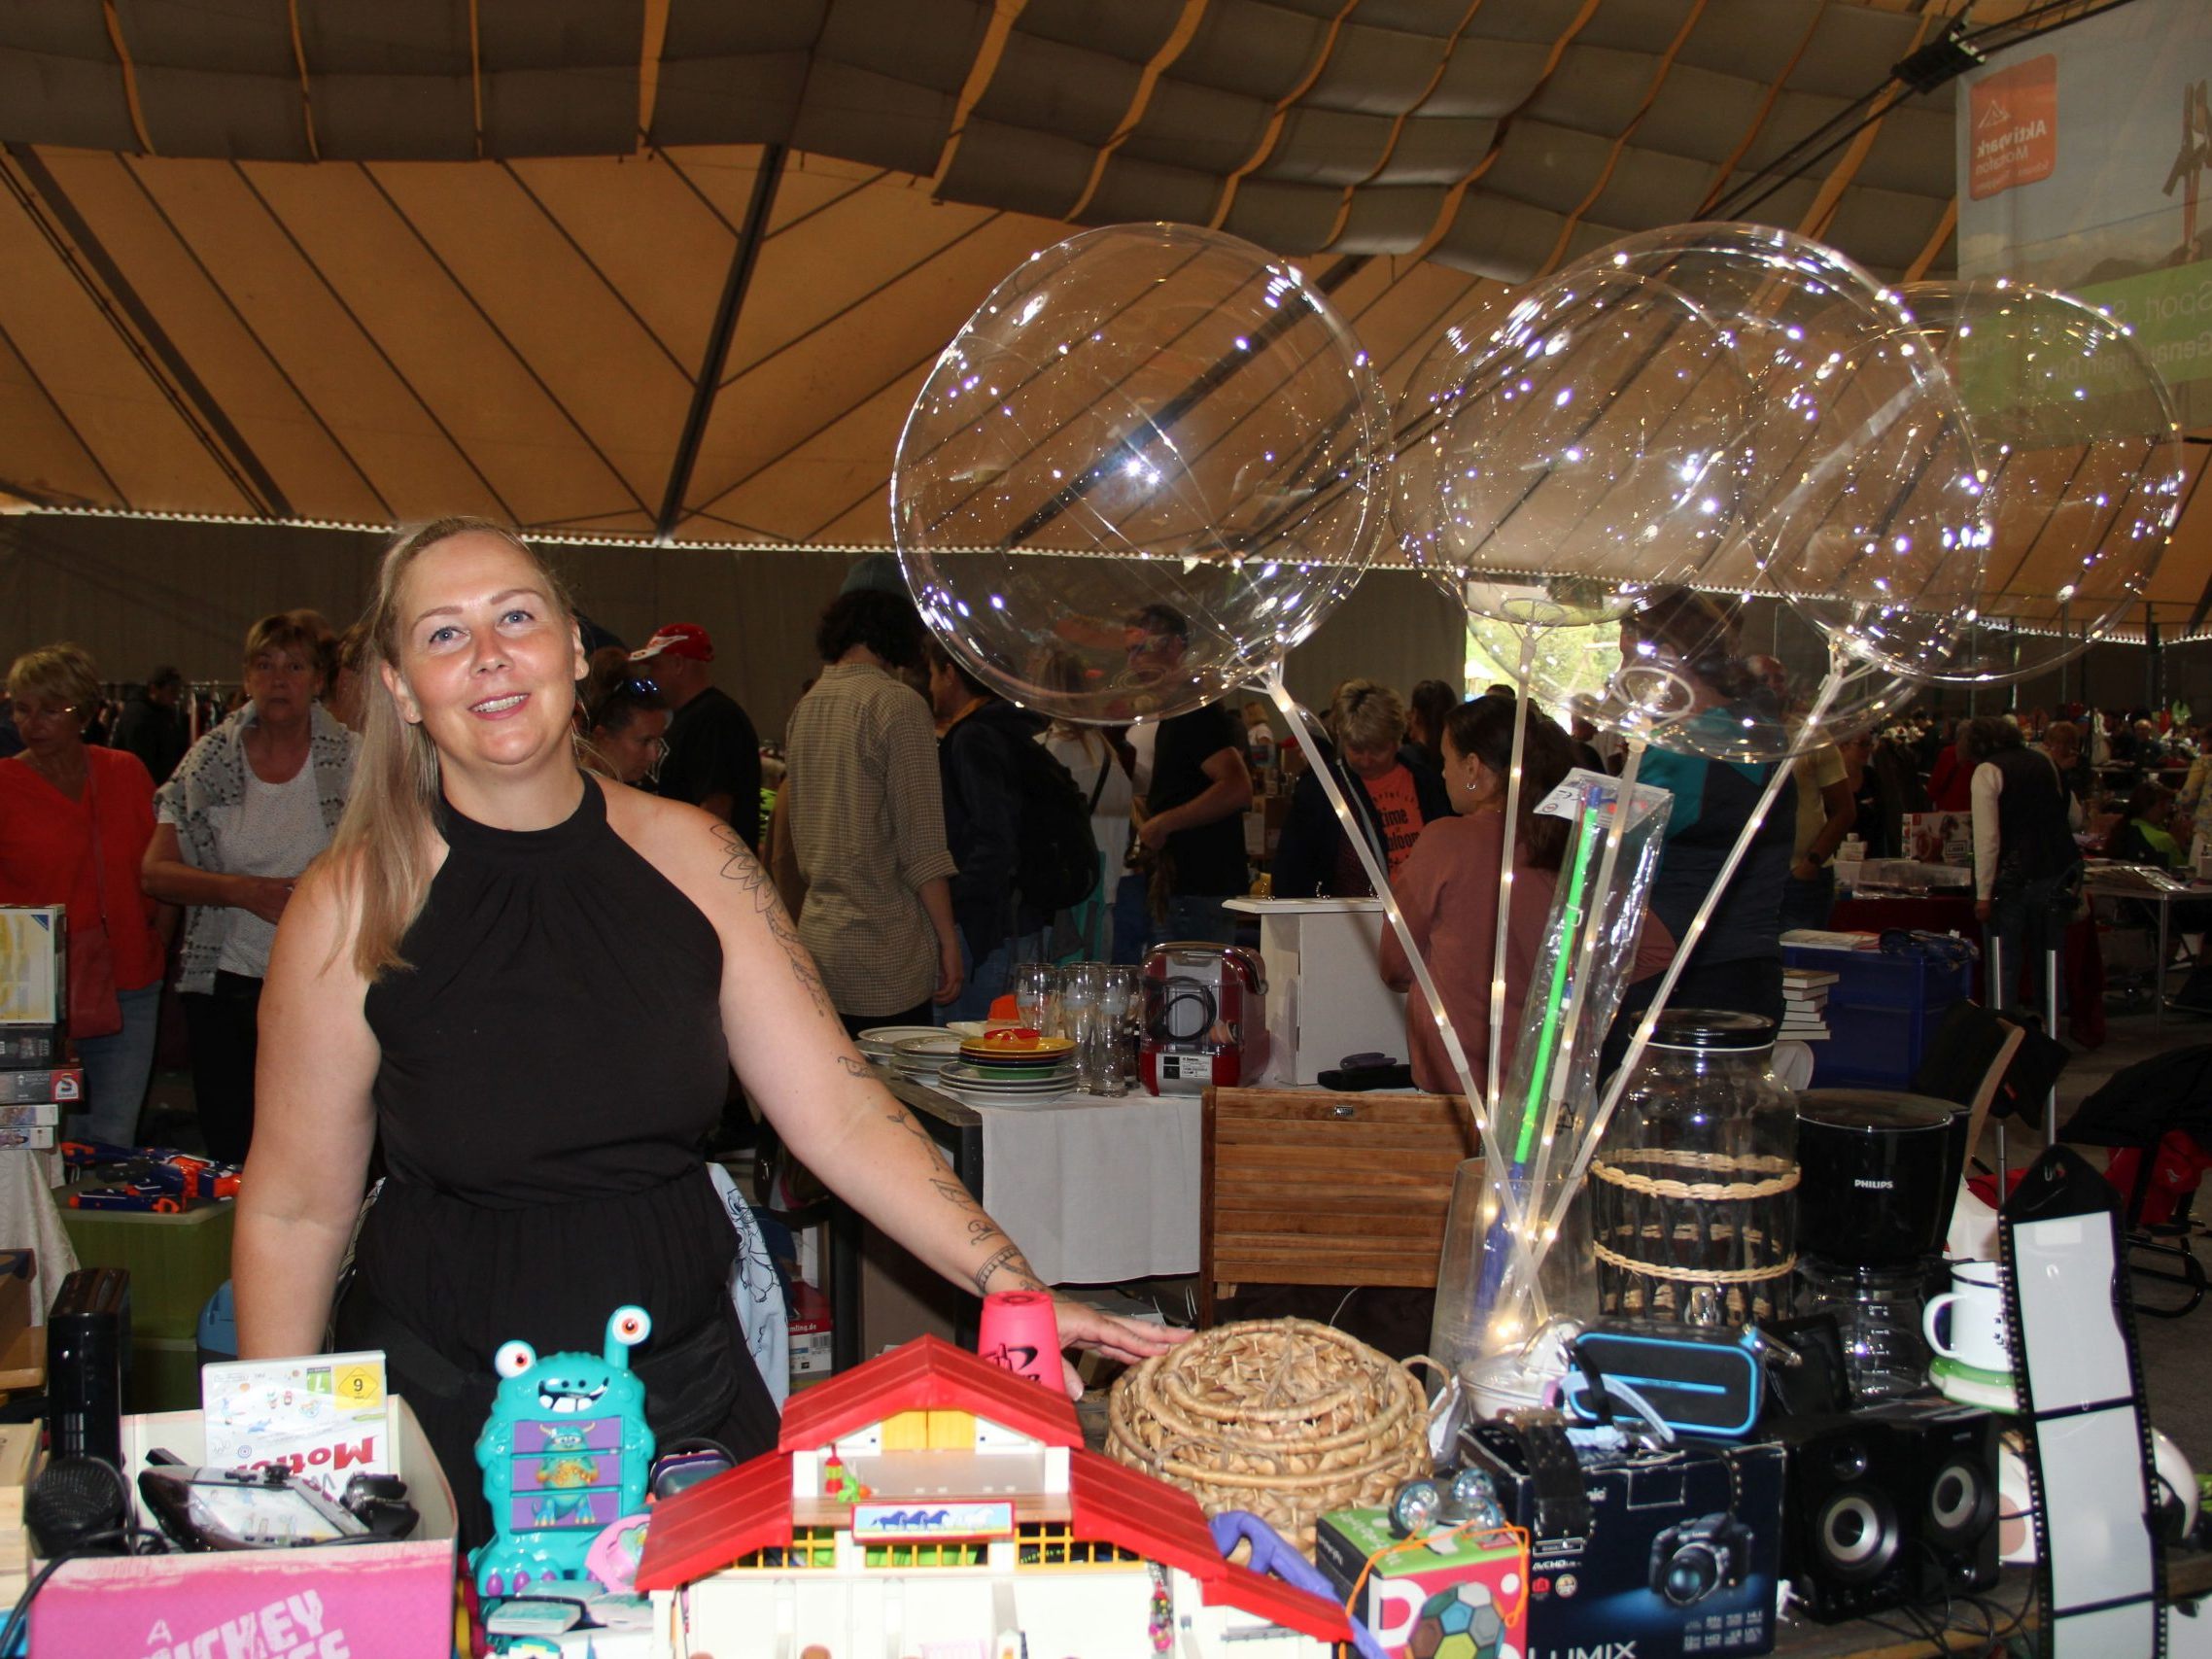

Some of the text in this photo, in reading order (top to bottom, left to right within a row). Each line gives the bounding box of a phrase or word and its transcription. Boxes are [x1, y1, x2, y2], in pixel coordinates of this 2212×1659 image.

[1854, 1179, 1894, 1189] PHILIPS
[232, 1434, 375, 1474] Moto
[140, 1588, 325, 1659] CKEY
[146, 1617, 173, 1645] A
